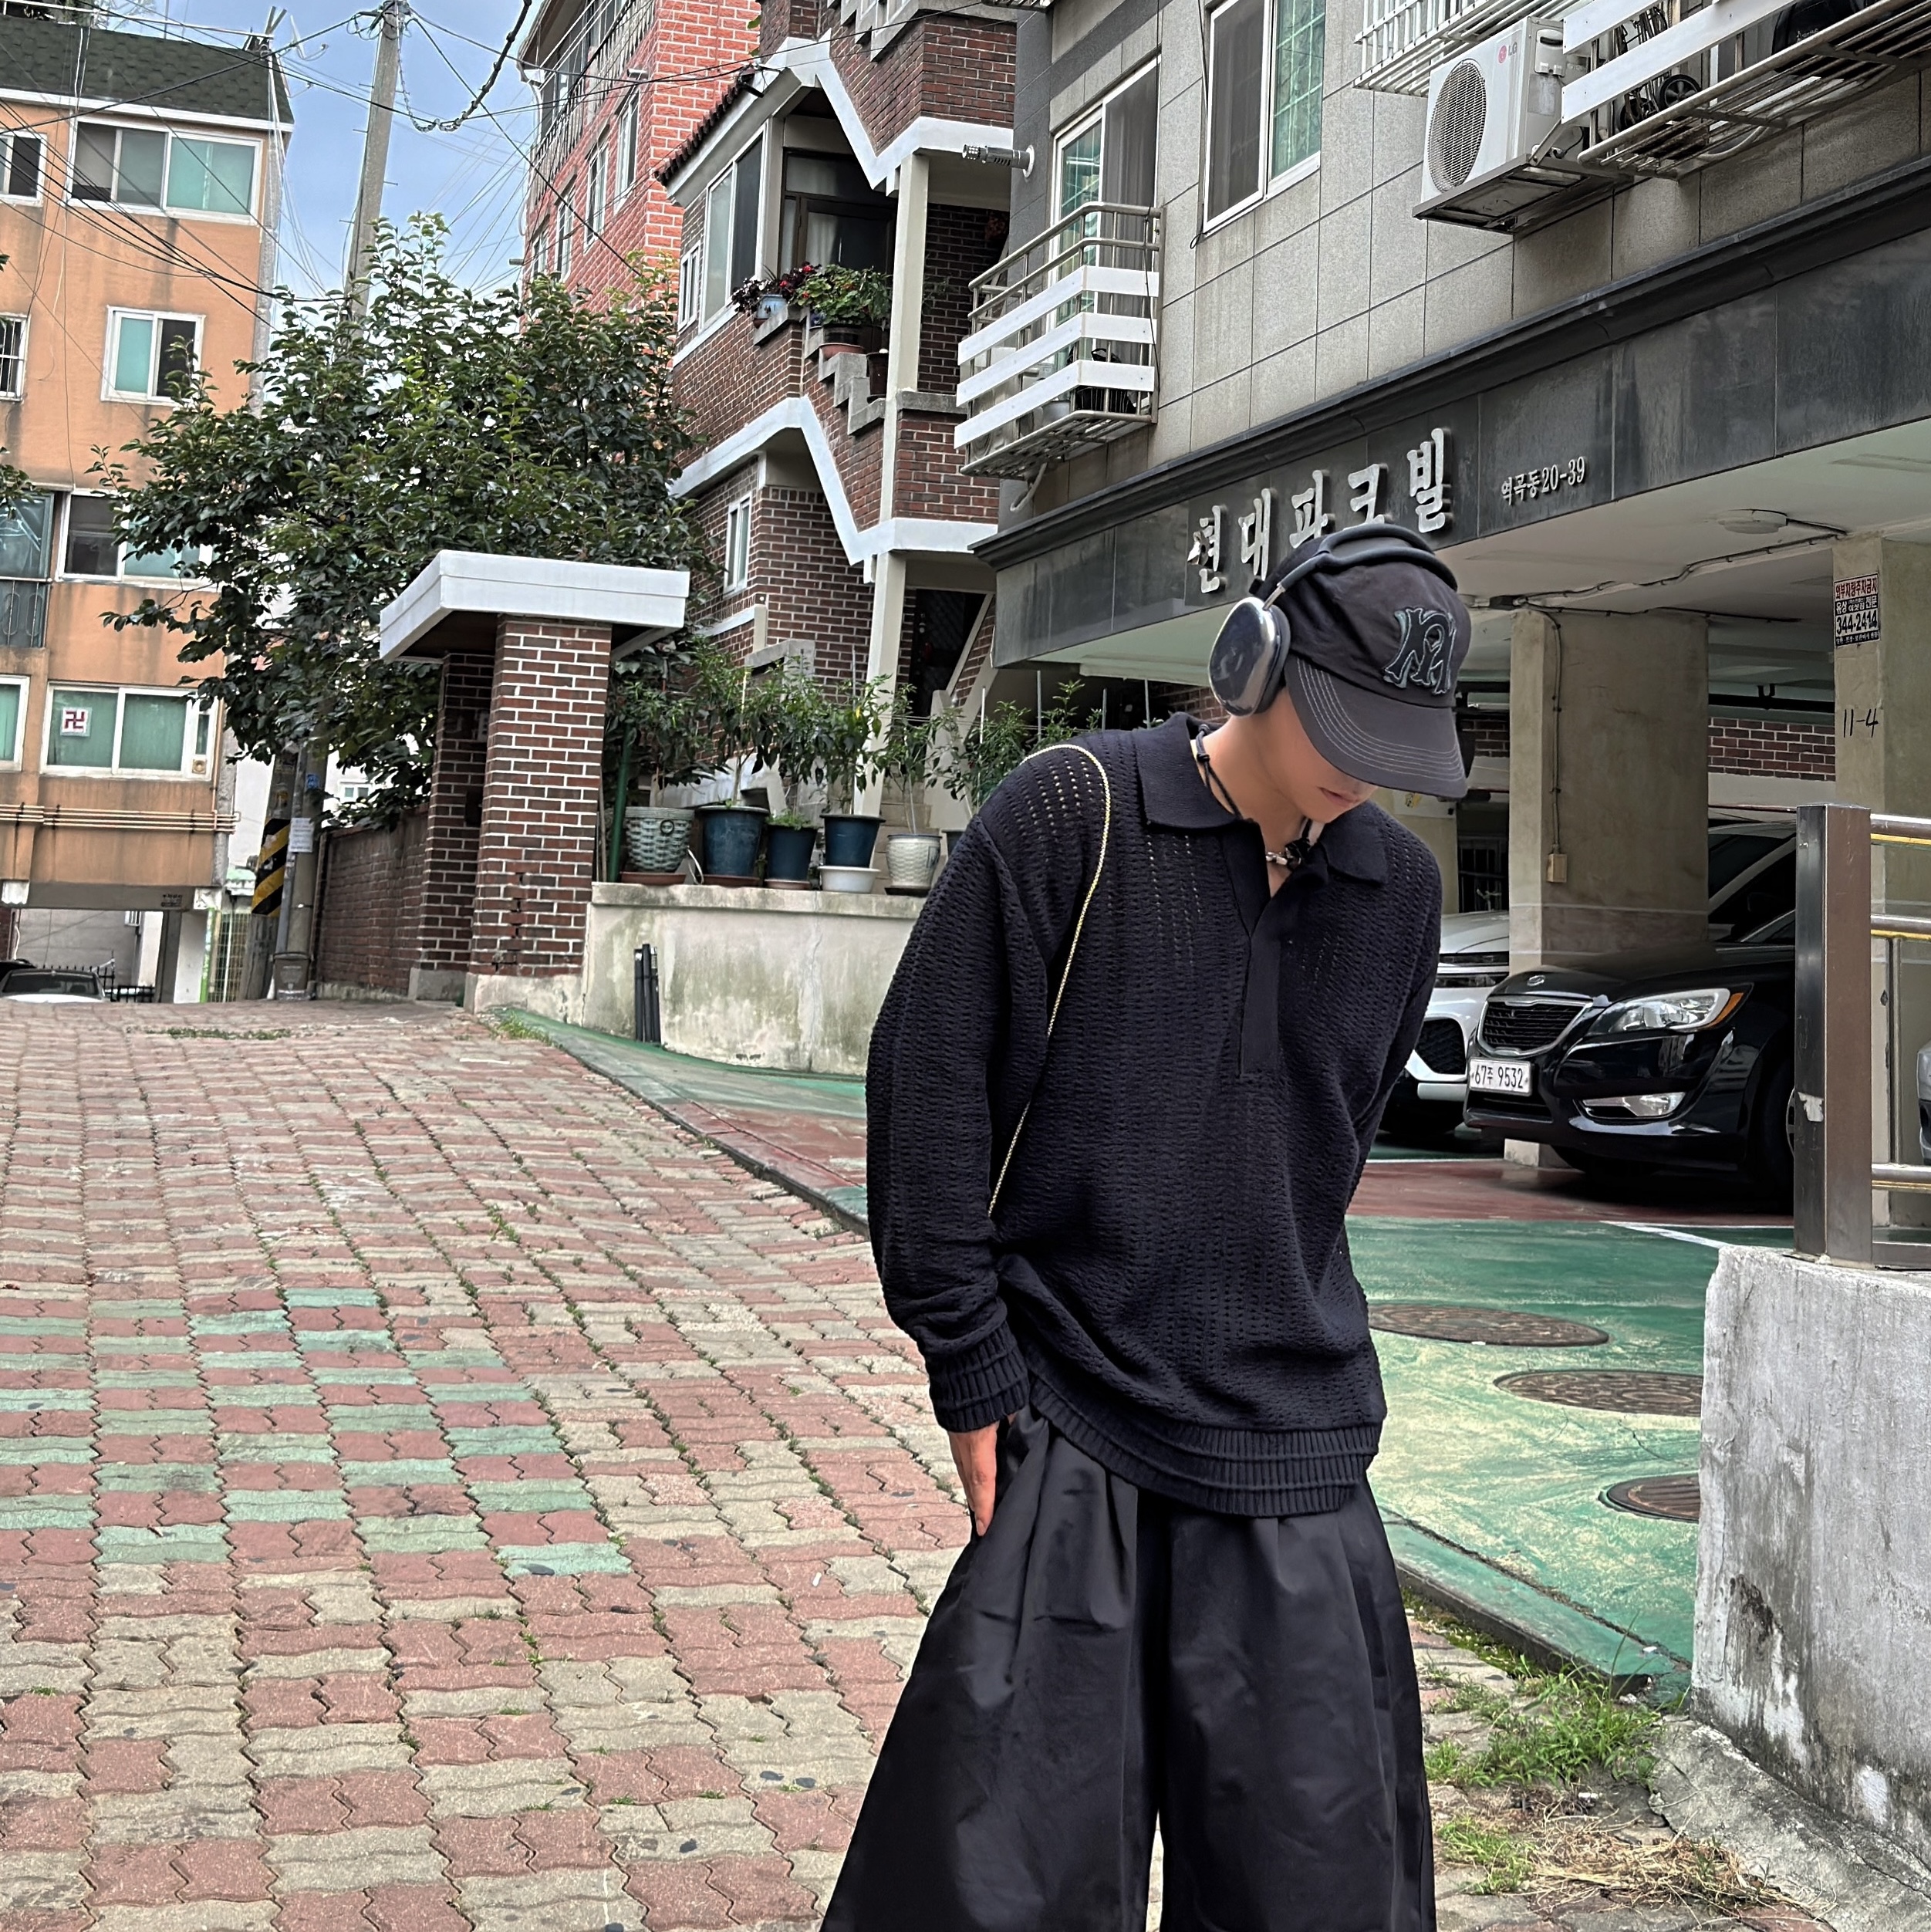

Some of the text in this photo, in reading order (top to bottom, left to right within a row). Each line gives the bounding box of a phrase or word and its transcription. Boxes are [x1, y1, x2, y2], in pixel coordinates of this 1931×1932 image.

[1508, 42, 1517, 56] LG
[1842, 708, 1879, 738] 11-4
[1474, 1064, 1524, 1089] 67주 9532
